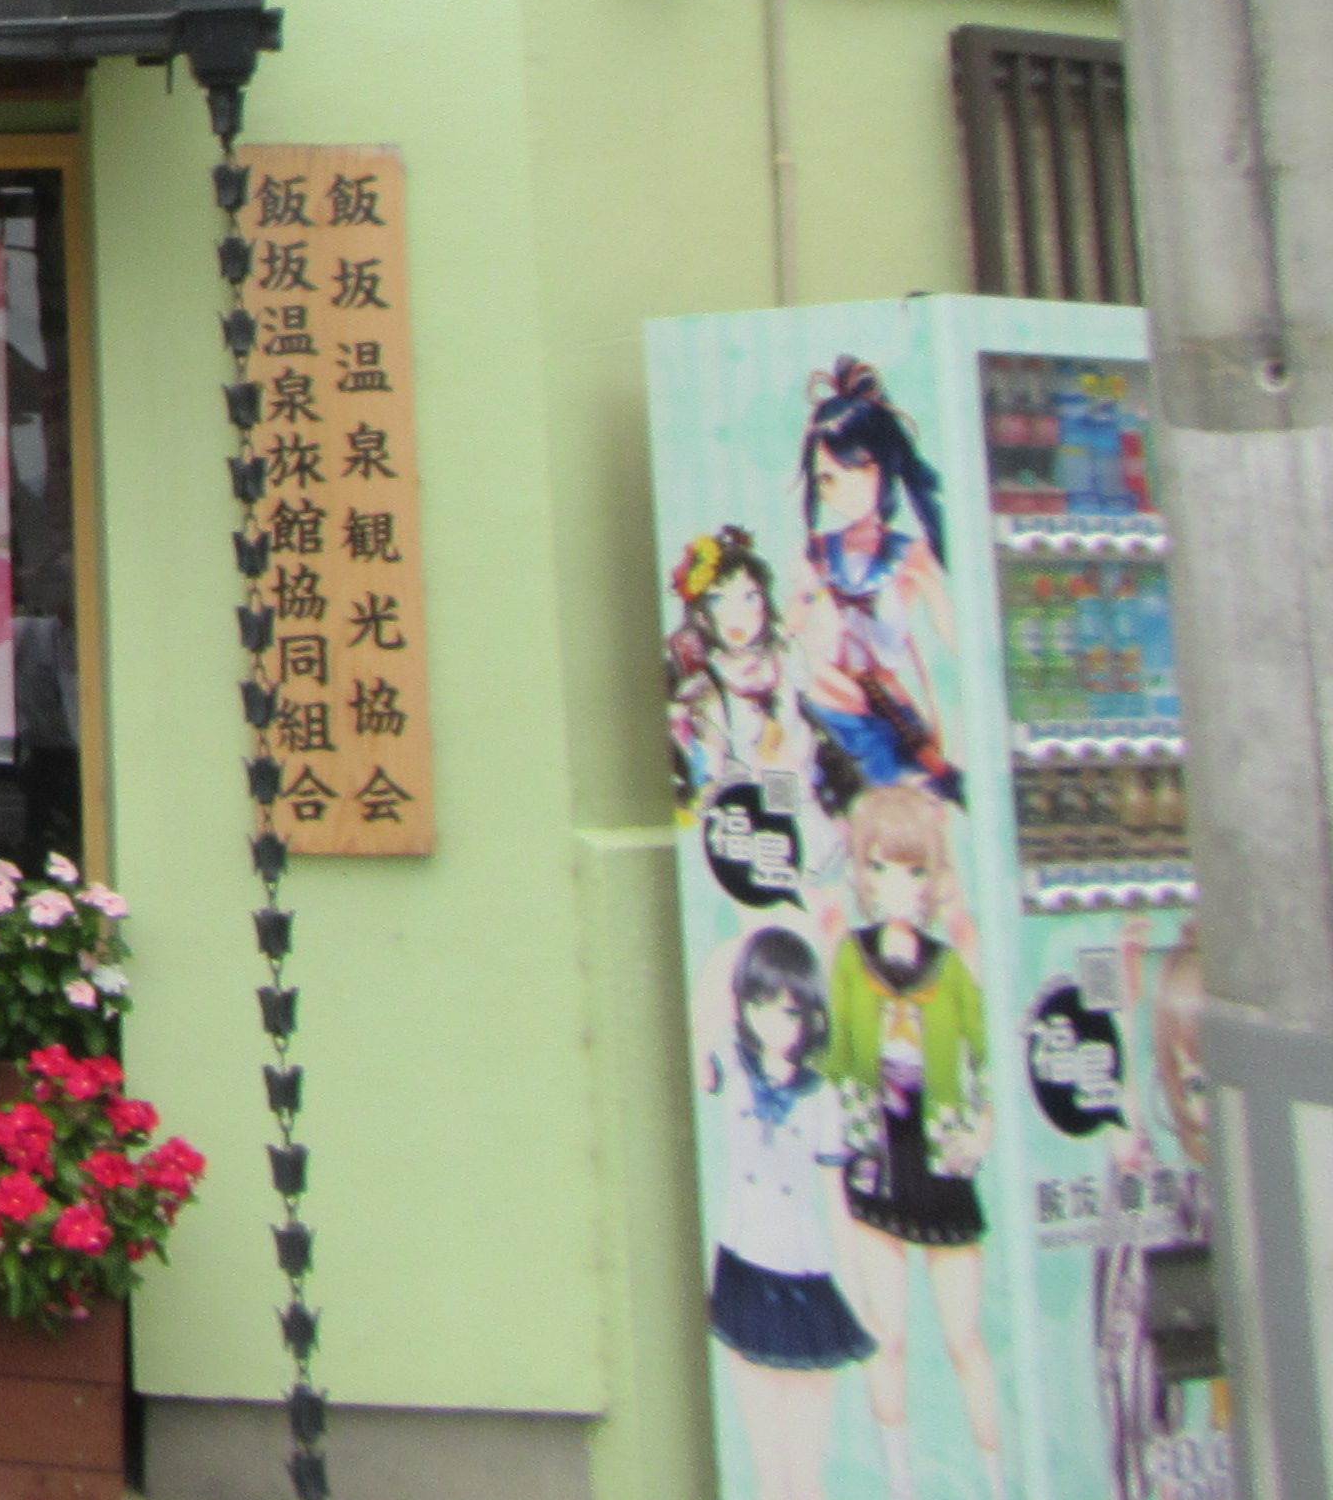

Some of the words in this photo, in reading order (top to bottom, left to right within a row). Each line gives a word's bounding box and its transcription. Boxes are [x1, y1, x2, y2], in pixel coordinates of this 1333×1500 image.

[253, 174, 339, 825] 飯坂温泉旅館協同組合
[324, 173, 415, 826] 飯坂温泉観光協会
